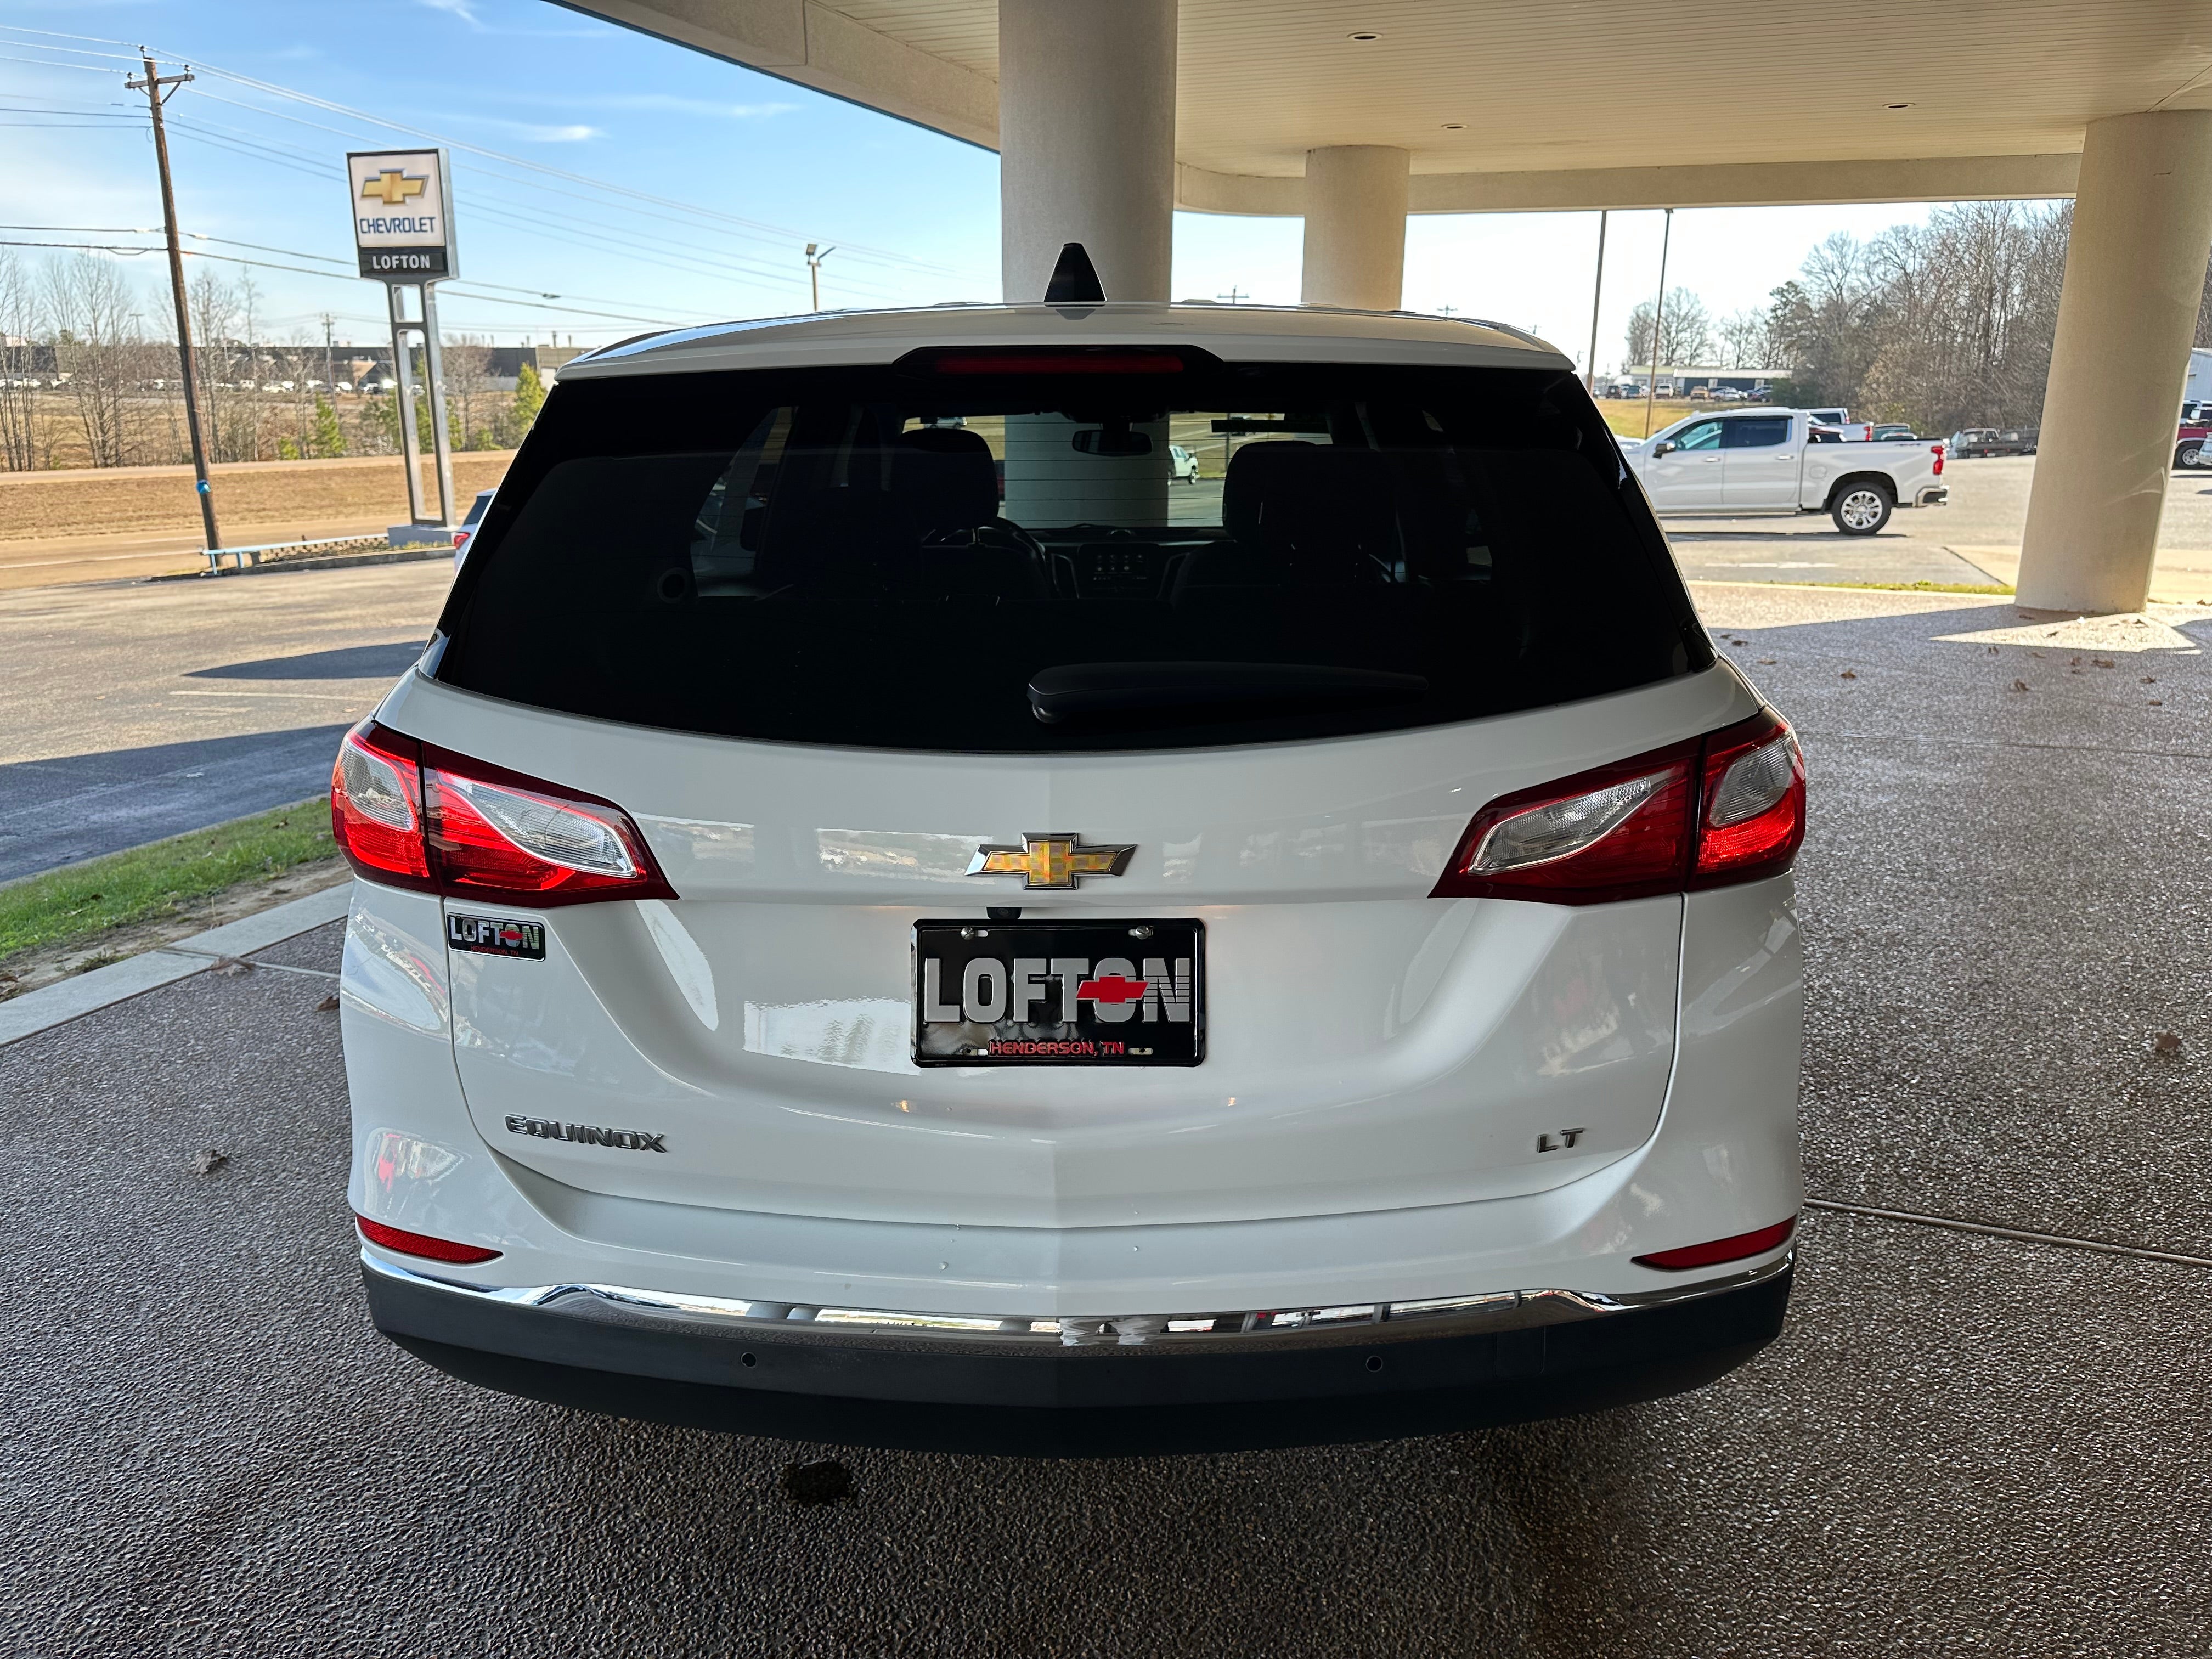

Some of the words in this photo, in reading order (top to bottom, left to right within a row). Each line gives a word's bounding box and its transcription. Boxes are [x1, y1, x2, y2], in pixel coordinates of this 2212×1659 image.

[360, 217, 436, 233] CHEVROLET
[373, 255, 430, 269] LOFTON
[450, 917, 539, 949] LOFTON
[924, 957, 1190, 1023] LOFTON
[990, 1042, 1098, 1057] HENDERSON,
[1102, 1041, 1124, 1054] TN
[505, 1113, 668, 1153] EQUINOX
[1537, 1127, 1585, 1153] LT
